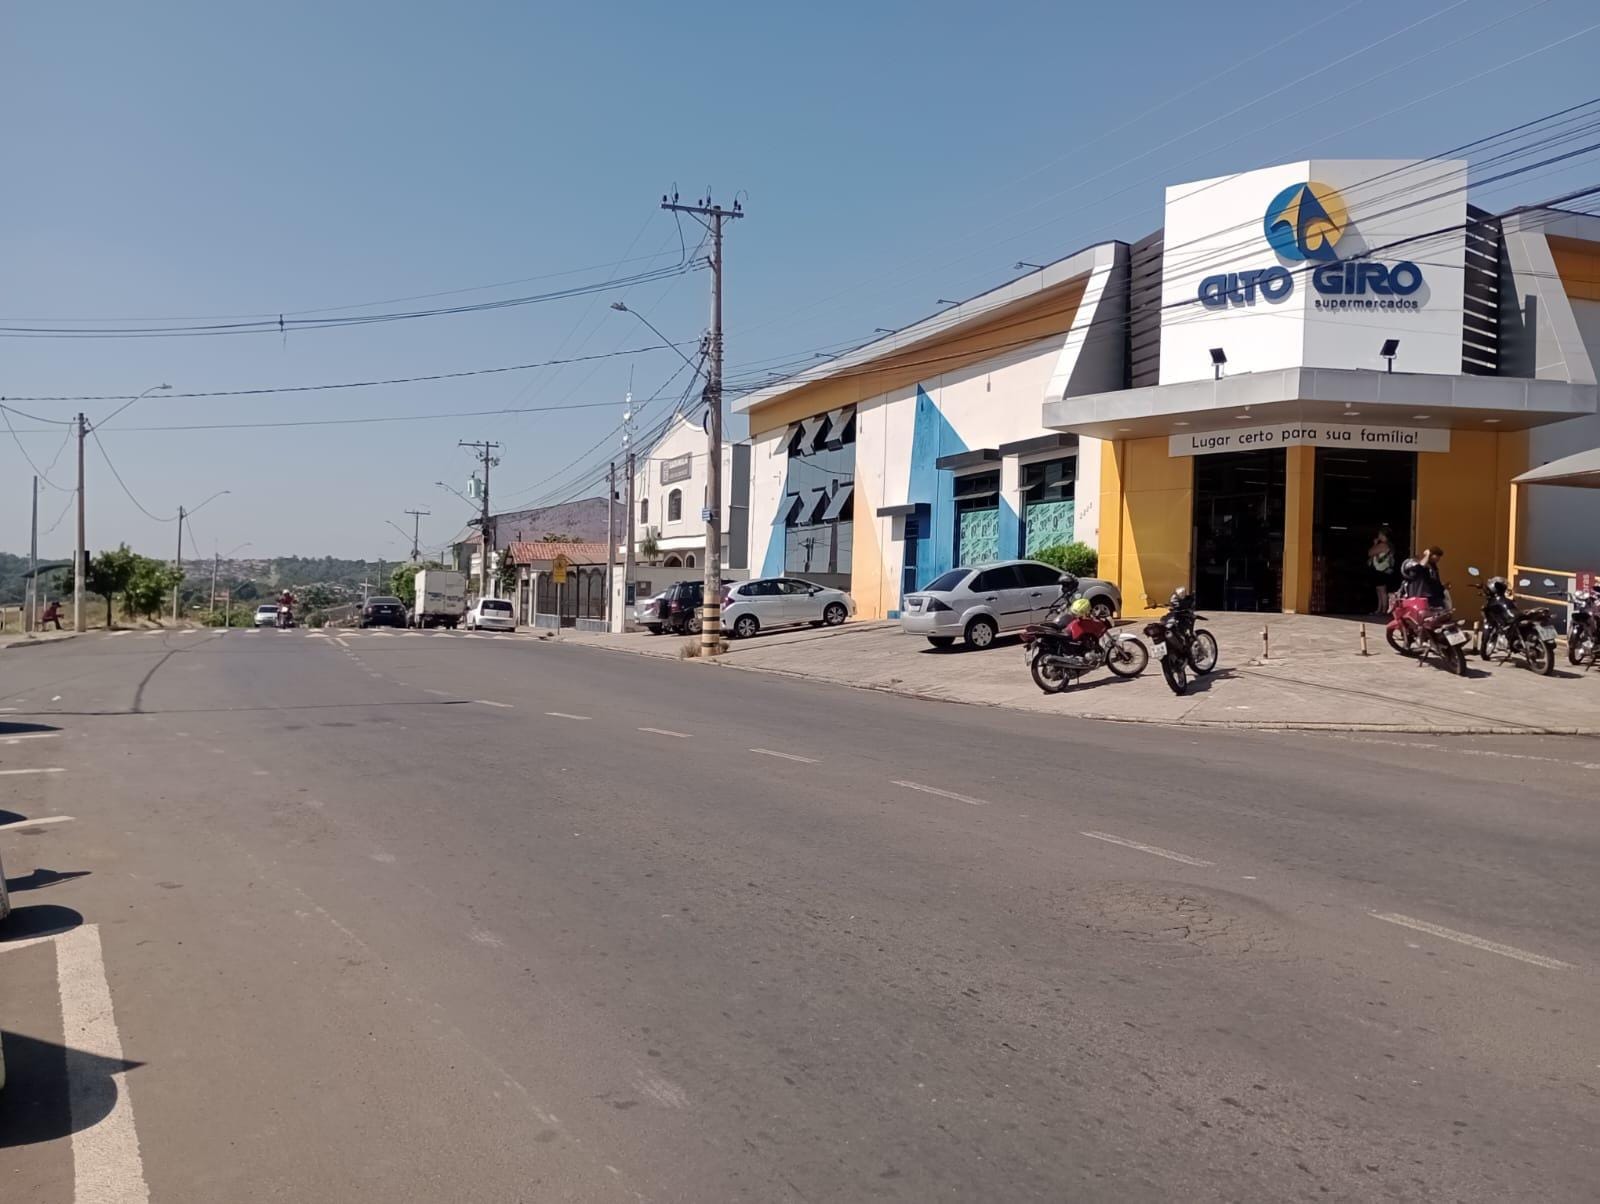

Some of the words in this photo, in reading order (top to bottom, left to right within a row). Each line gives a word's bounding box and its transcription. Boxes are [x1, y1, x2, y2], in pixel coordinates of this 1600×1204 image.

[1198, 266, 1293, 306] ALTO
[1312, 262, 1422, 295] GIRO
[1315, 298, 1419, 311] supermercados
[1192, 436, 1231, 448] Lugar
[1239, 430, 1274, 444] certo
[1282, 428, 1317, 442] para
[1326, 430, 1352, 441] sua
[1361, 428, 1418, 444] família!
